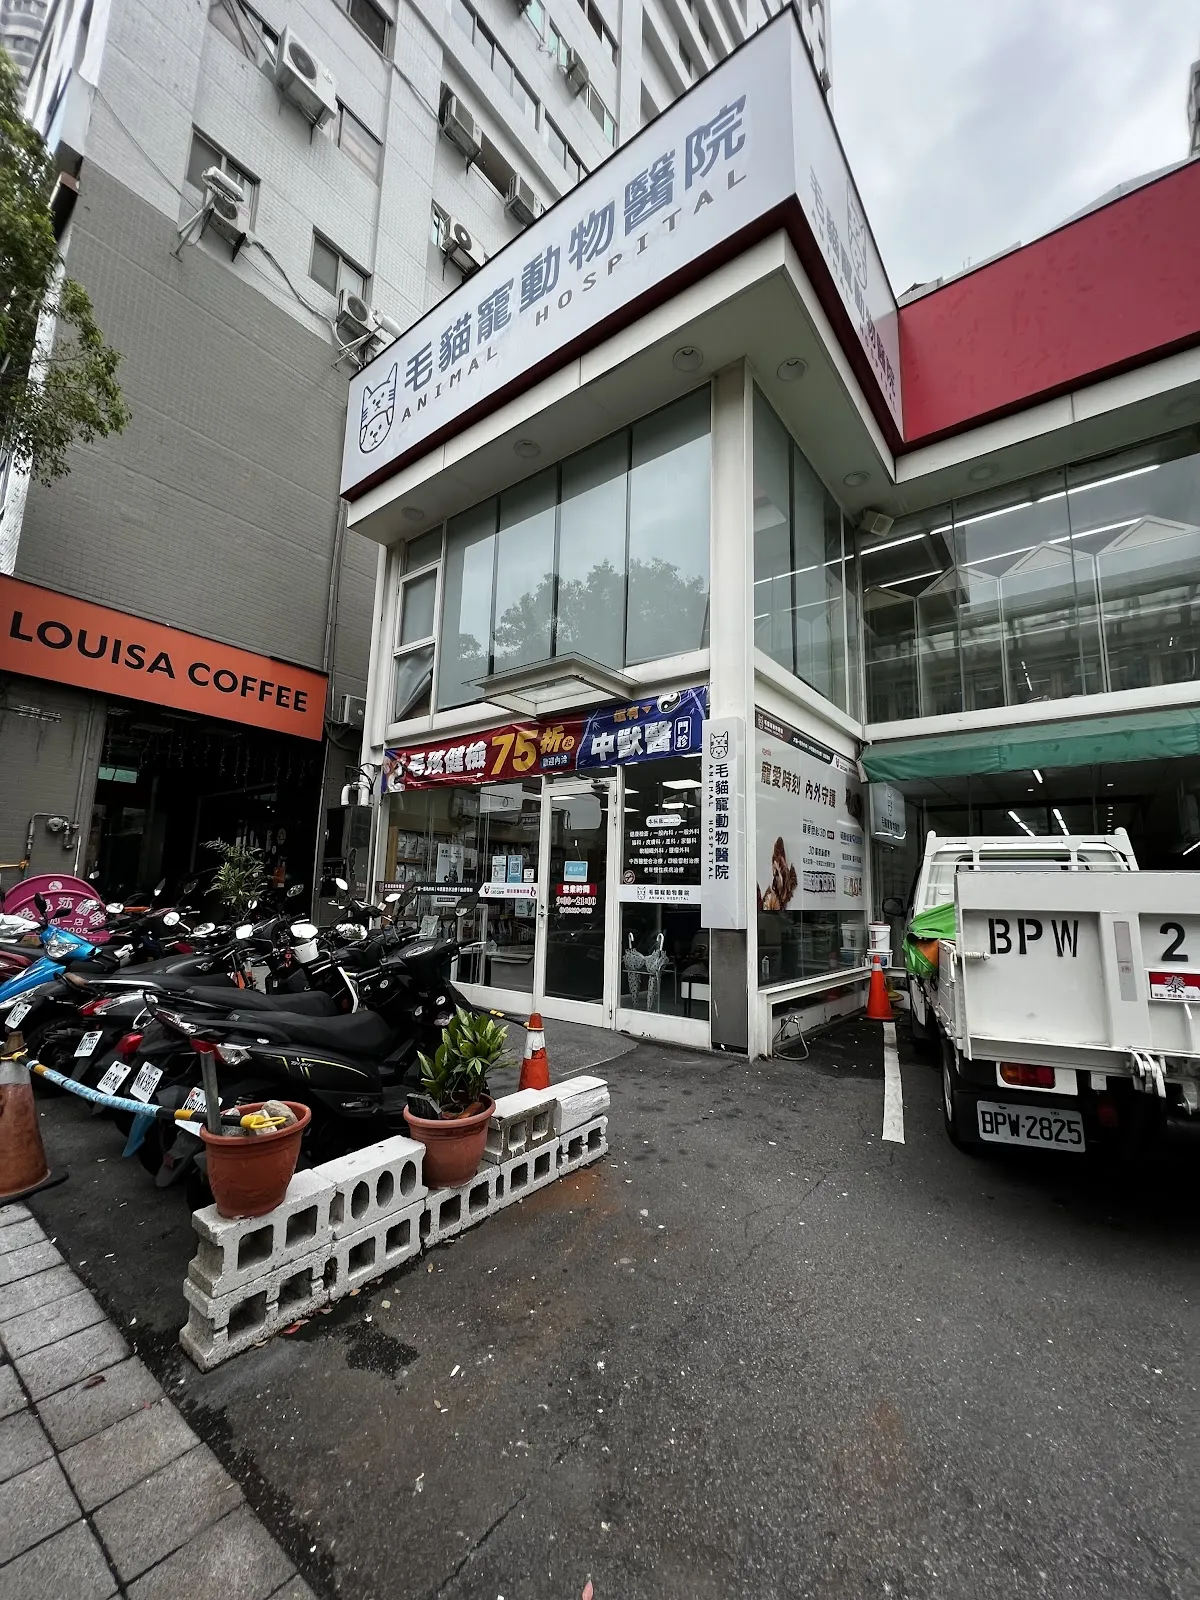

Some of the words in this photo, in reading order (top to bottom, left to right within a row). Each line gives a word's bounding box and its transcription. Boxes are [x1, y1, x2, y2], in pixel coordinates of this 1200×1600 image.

[404, 94, 747, 393] 毛貓寵動物醫院
[401, 349, 498, 423] ANIMAL
[535, 170, 747, 327] HOSPITAL
[9, 611, 176, 680] LOUISA
[188, 662, 308, 713] COFFEE
[715, 763, 729, 880] 毛貓寵動物醫院
[987, 917, 1079, 958] BPW
[1160, 922, 1189, 962] 2
[1164, 975, 1186, 994] 泰
[981, 1110, 1083, 1144] BPW-2825
